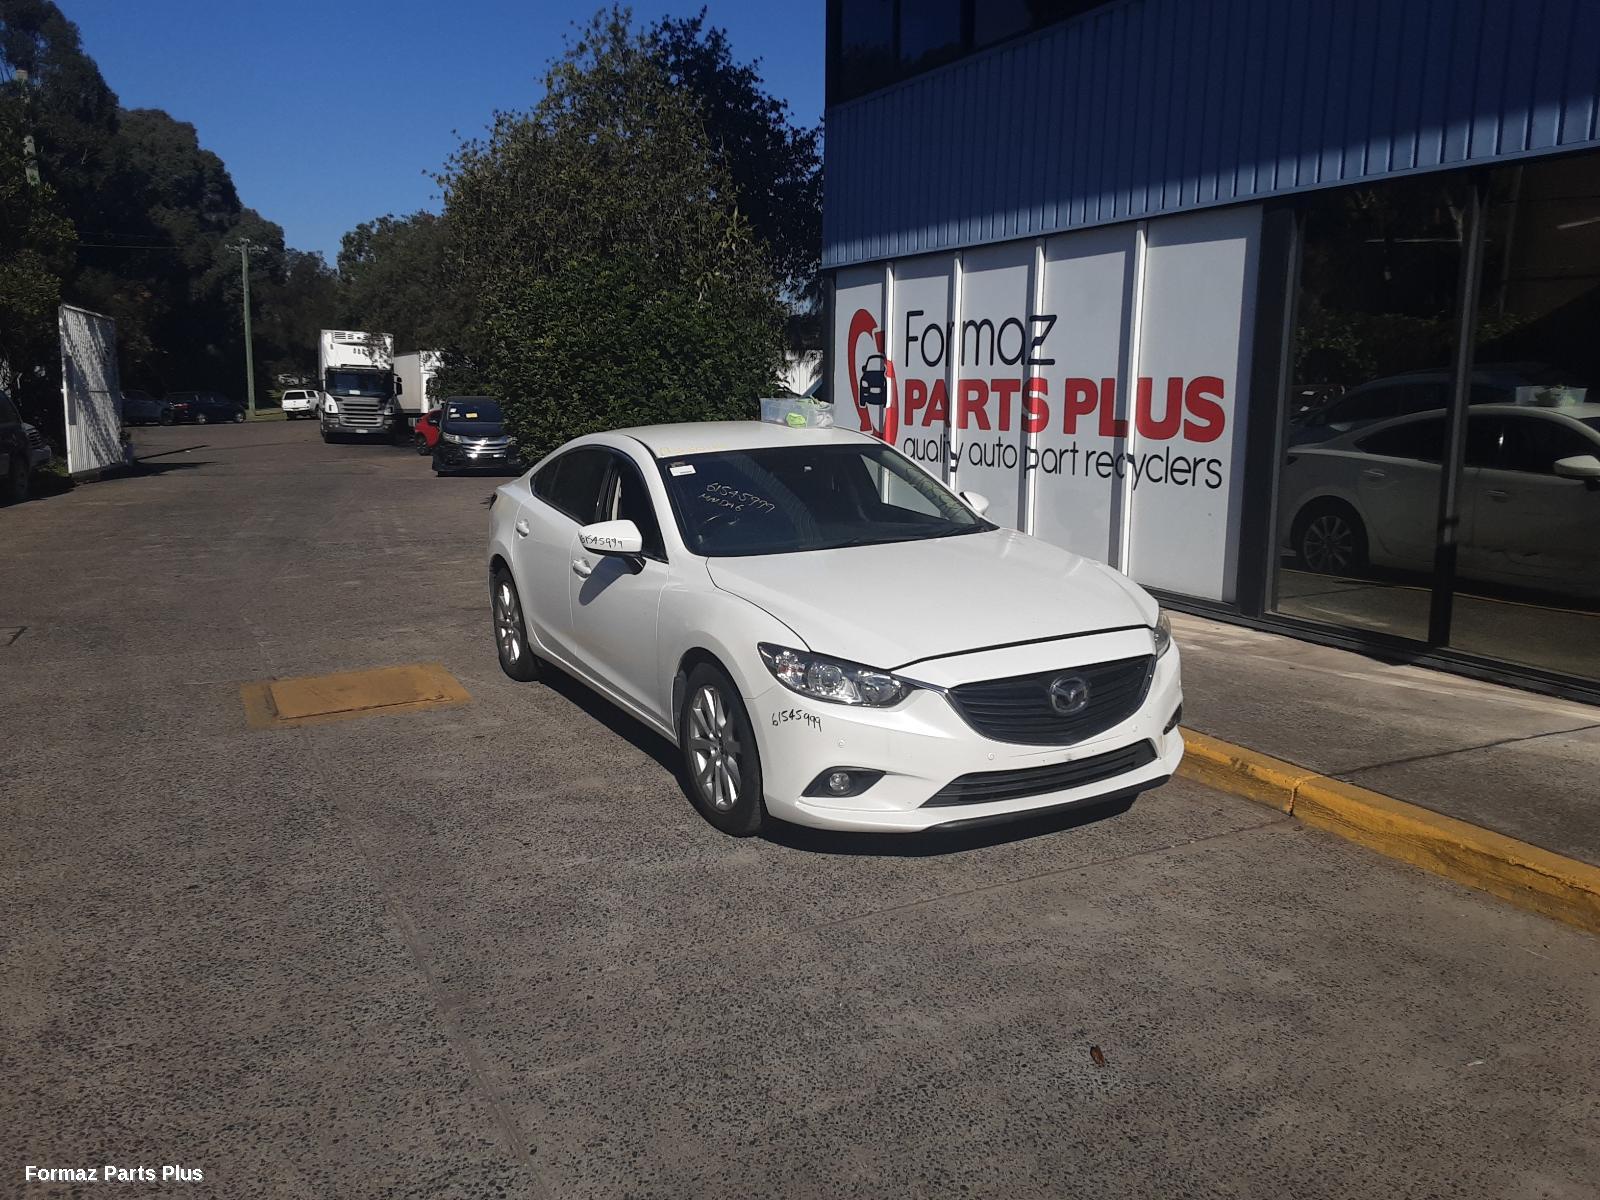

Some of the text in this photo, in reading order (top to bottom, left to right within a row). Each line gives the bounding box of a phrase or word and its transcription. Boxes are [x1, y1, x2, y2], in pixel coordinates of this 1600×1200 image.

[905, 309, 1058, 368] Formaz
[903, 375, 1226, 443] PARTS PLUS
[968, 435, 1018, 469] auto
[1023, 441, 1079, 480] part
[1085, 446, 1223, 491] recyclers
[771, 708, 822, 733] 61545999
